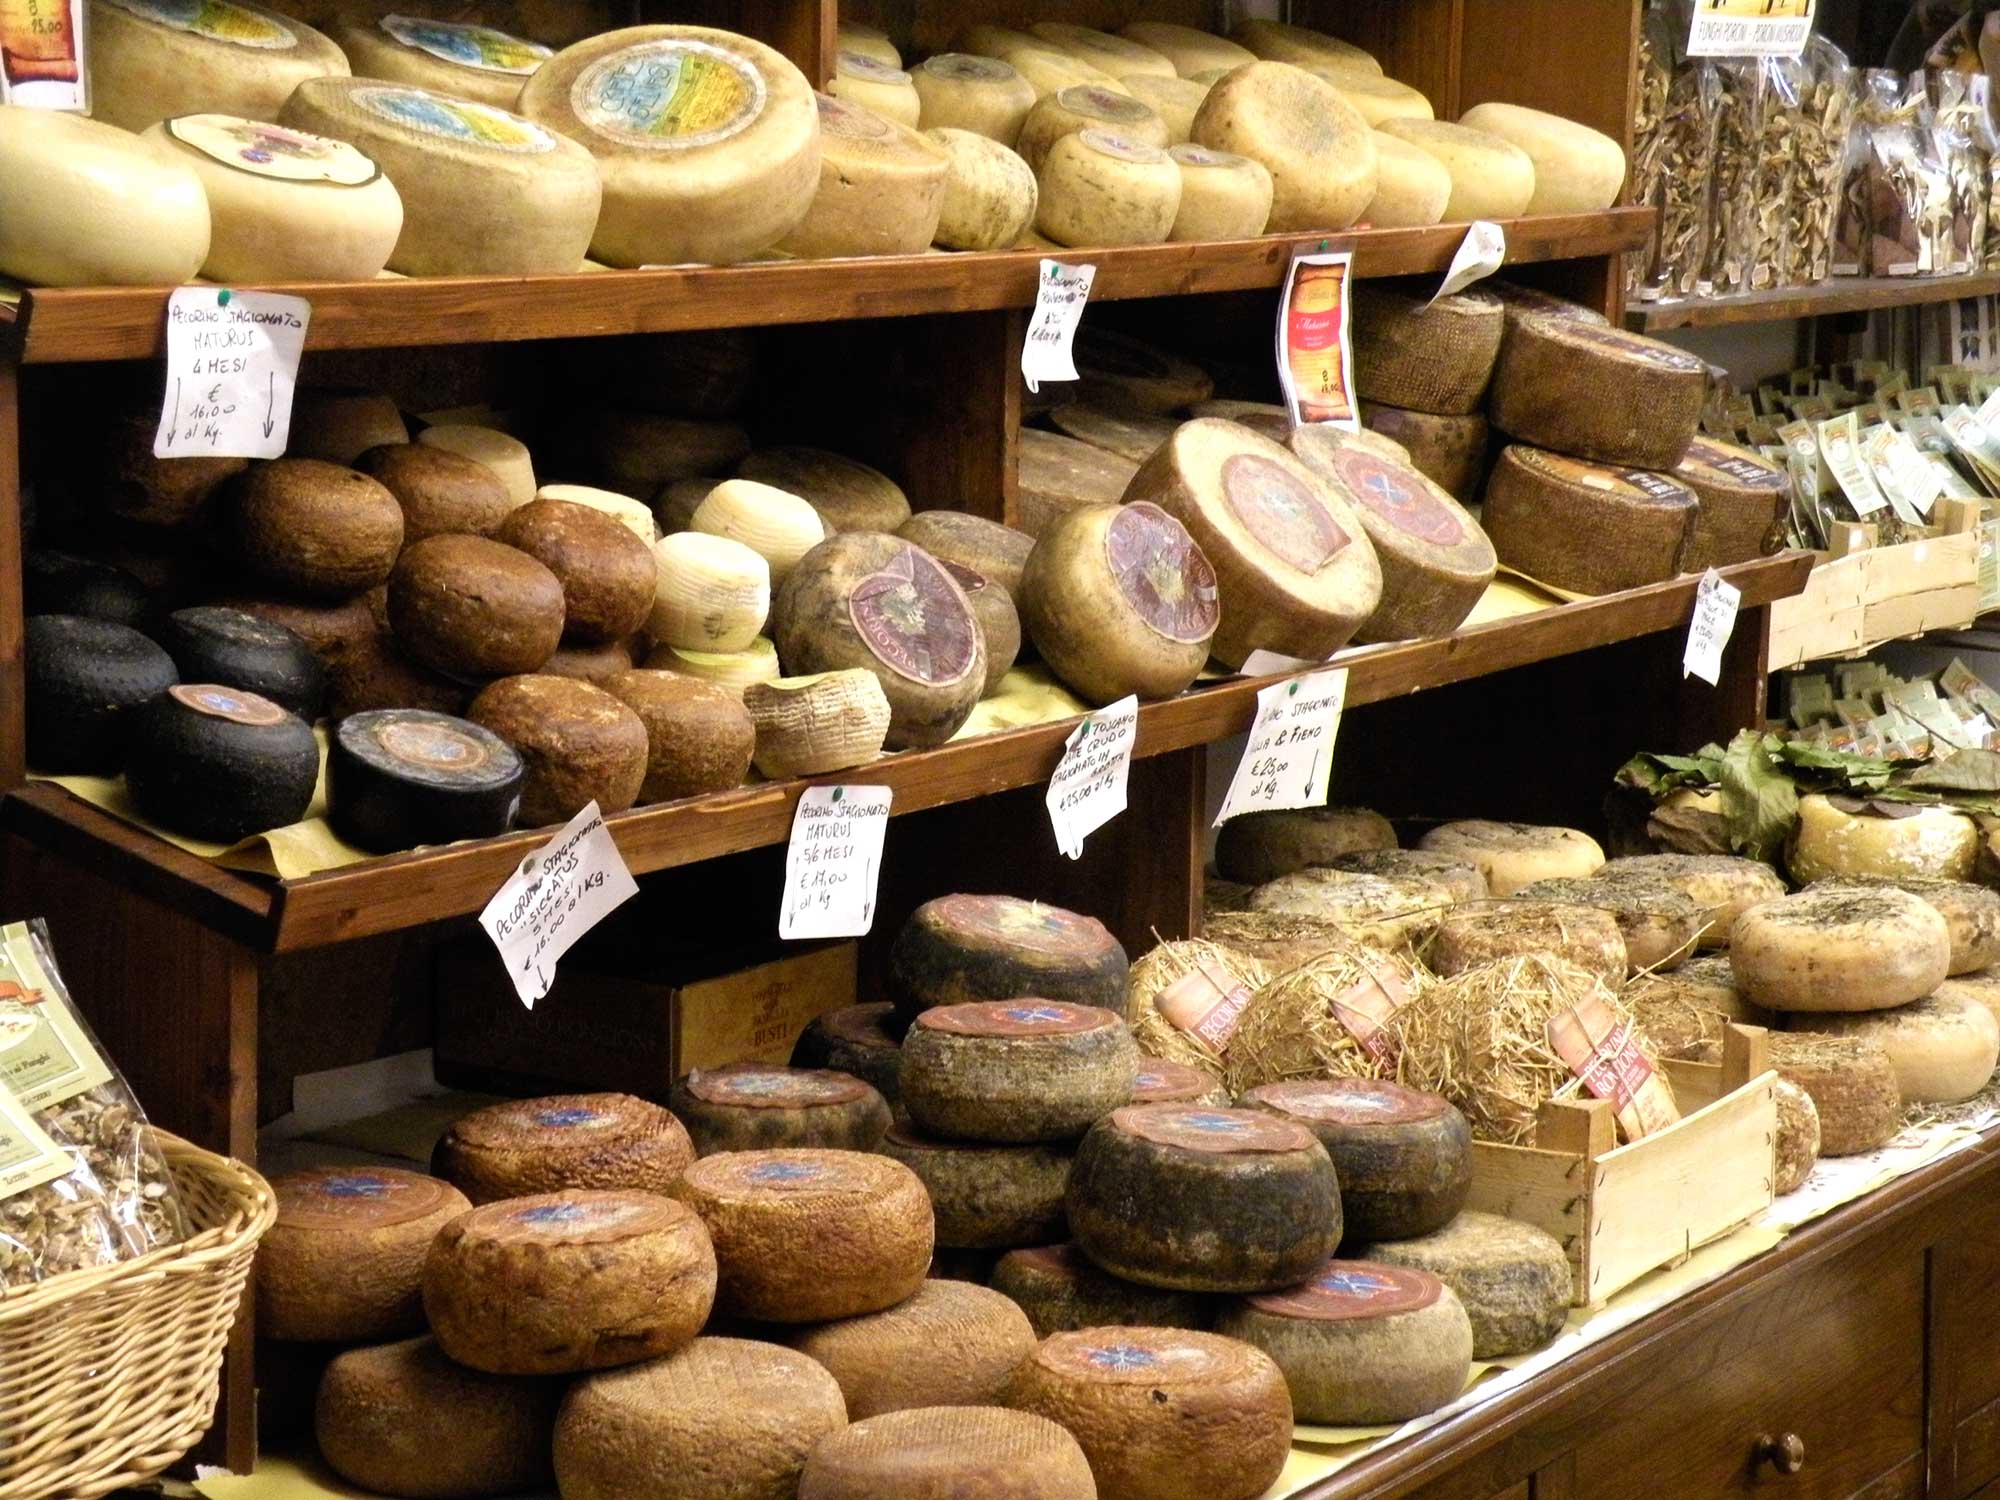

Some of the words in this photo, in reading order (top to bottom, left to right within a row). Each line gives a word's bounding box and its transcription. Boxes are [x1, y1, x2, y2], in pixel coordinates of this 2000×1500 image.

[172, 304, 219, 324] PECORINO
[224, 306, 302, 328] STAGIONATO
[194, 328, 254, 350] MATURUS
[208, 357, 247, 374] MESI
[1087, 729, 1127, 753] CRUDO
[1289, 726, 1323, 744] FIENO
[800, 802, 834, 819] PECORINO
[834, 800, 888, 819] STAGIONATO
[806, 822, 851, 840] MATURUS
[823, 845, 854, 860] MESI
